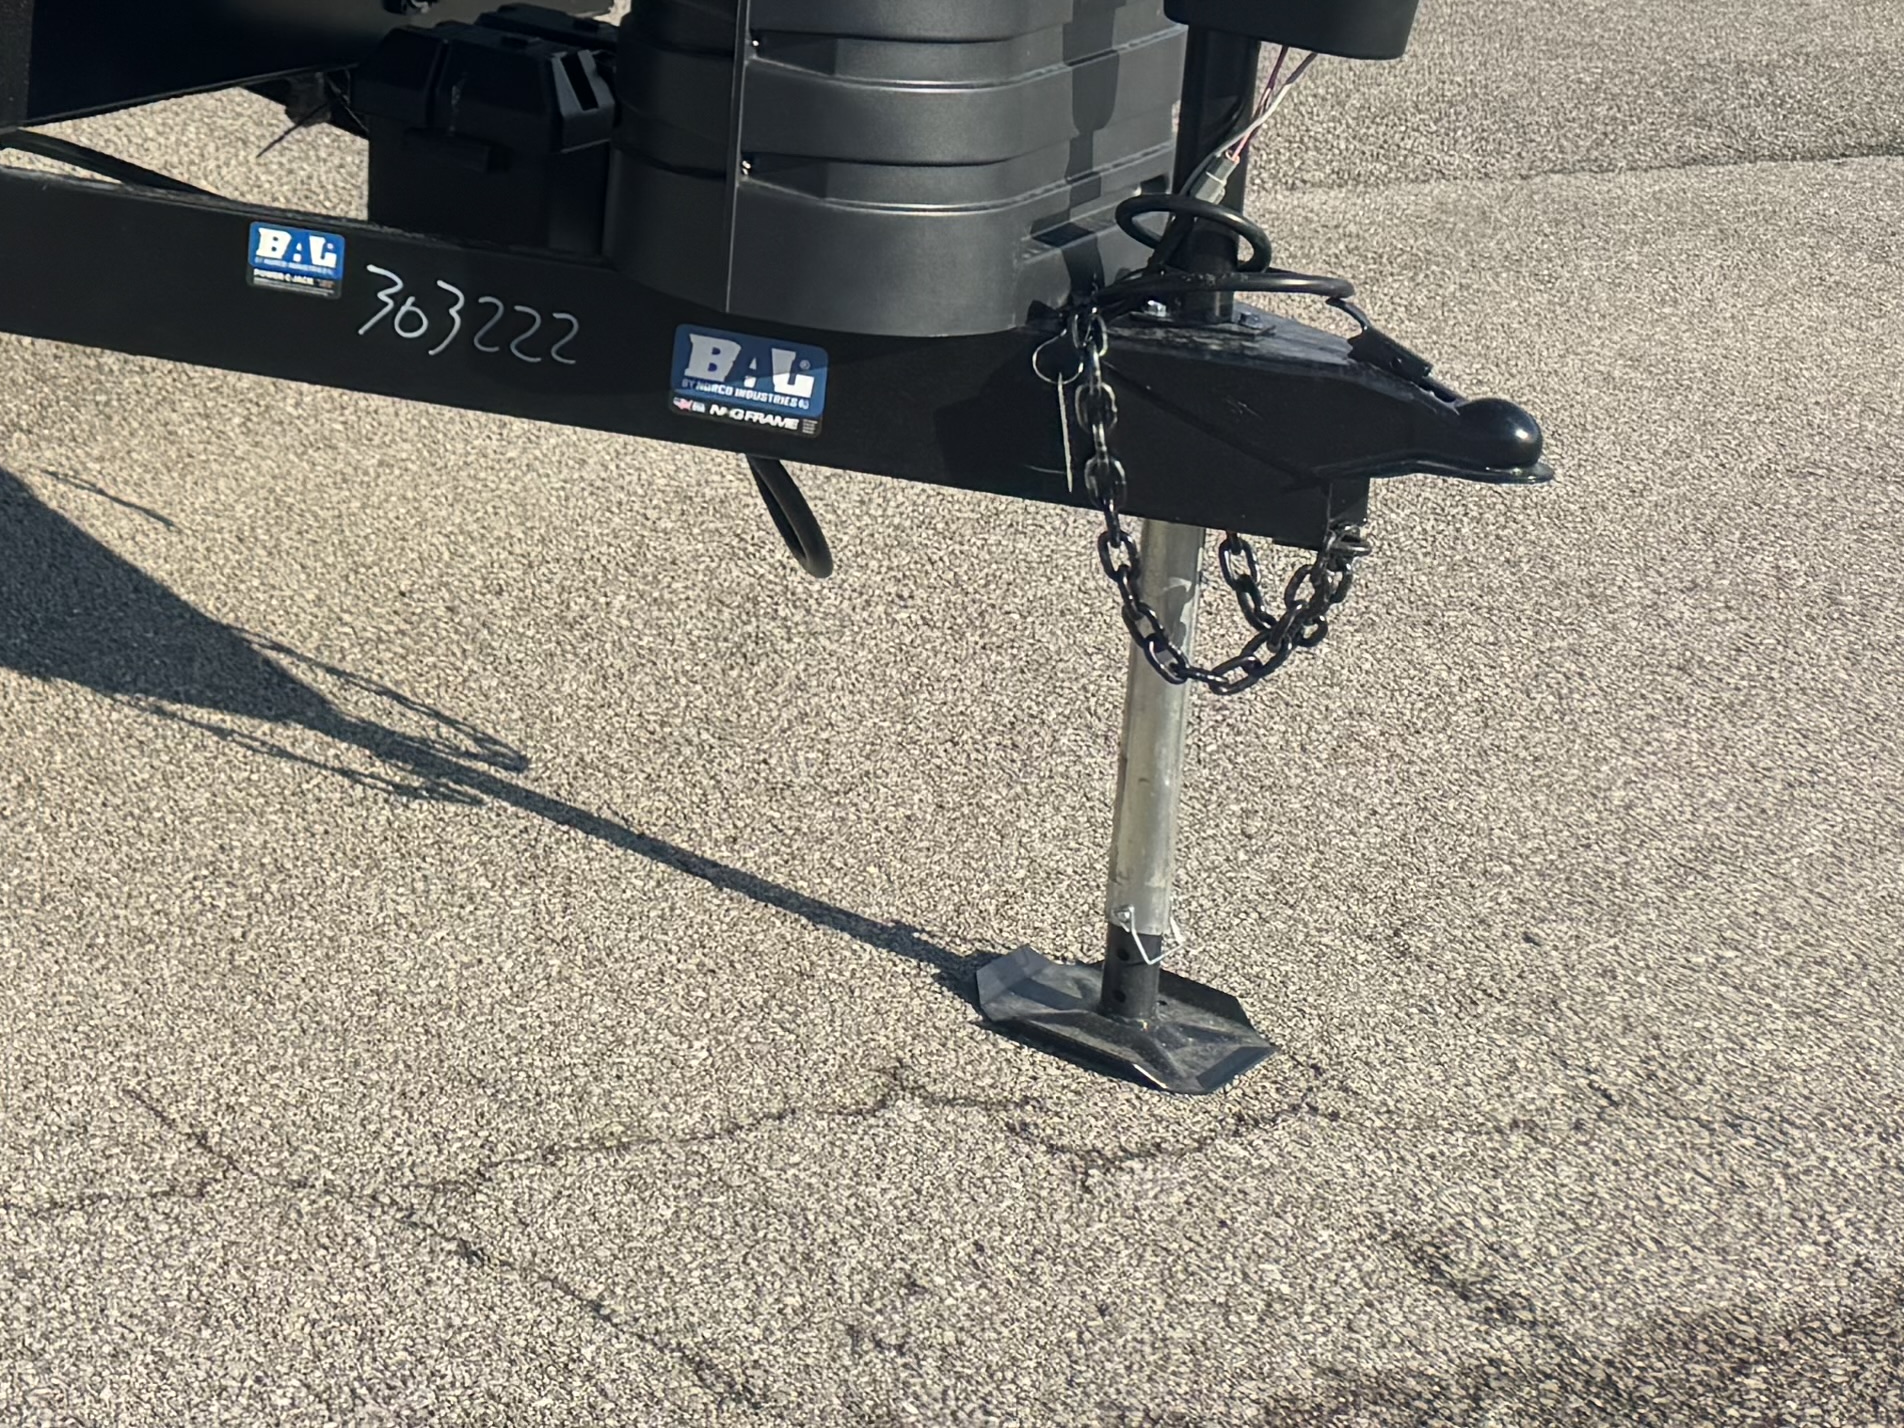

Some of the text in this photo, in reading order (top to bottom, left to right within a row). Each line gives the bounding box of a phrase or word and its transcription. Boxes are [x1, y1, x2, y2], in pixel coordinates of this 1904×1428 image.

[255, 226, 338, 269] BAL
[684, 333, 815, 399] BAL
[681, 378, 798, 410] BY NORCO INDUSTRIES
